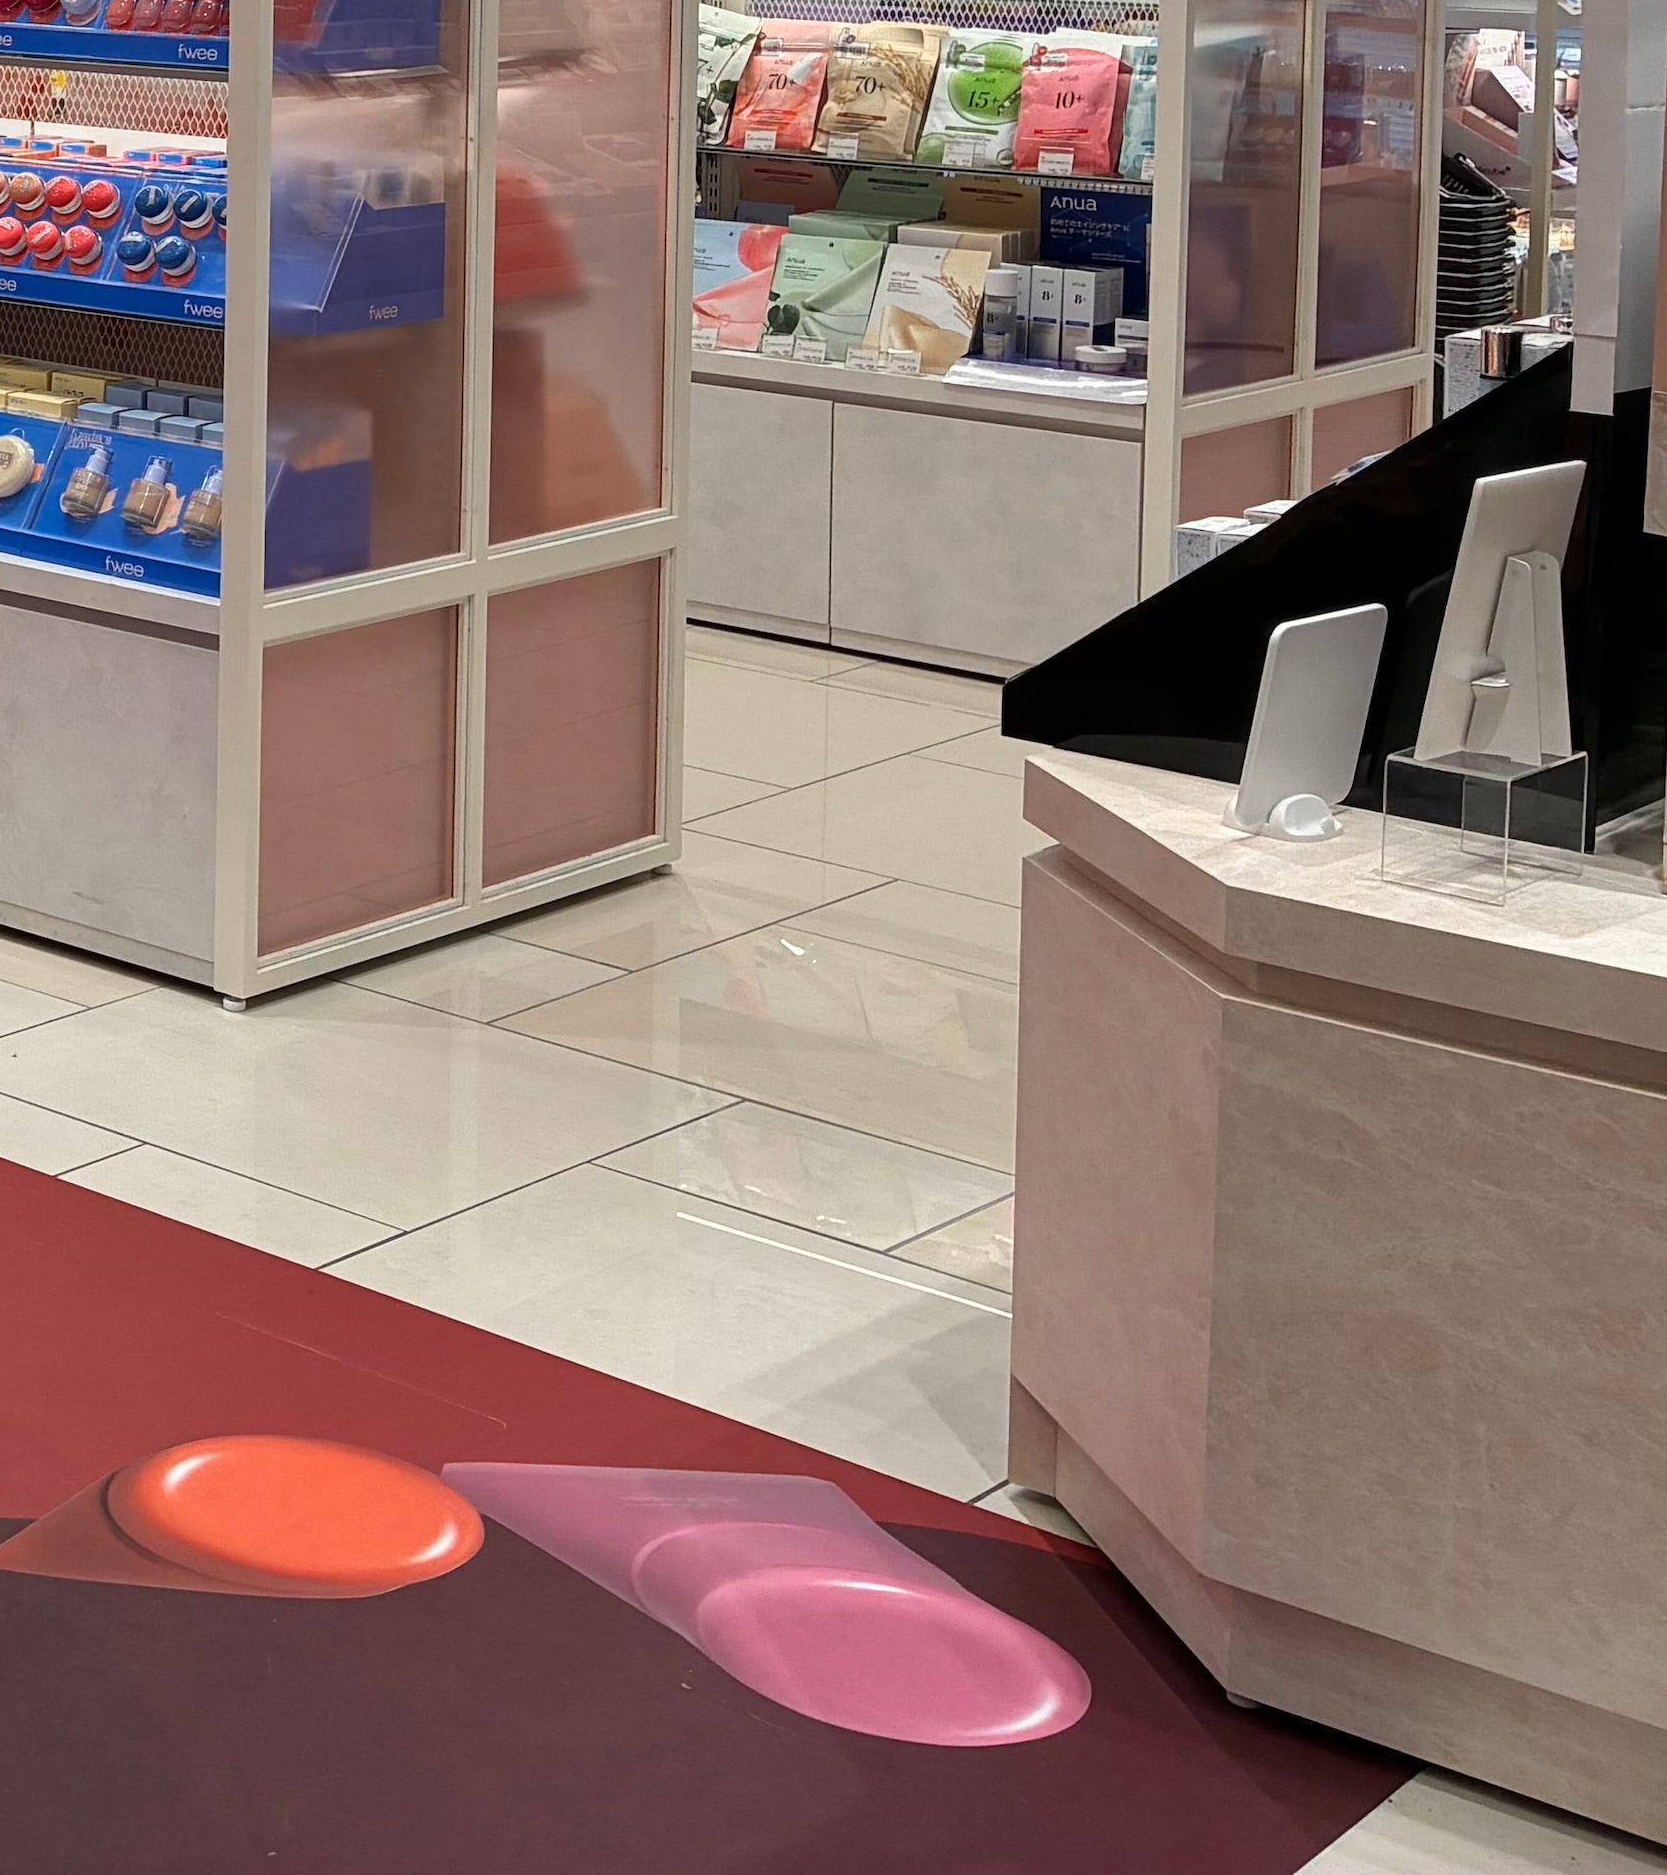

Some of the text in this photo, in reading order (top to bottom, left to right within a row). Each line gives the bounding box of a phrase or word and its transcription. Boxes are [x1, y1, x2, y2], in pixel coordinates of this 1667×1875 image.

[177, 43, 219, 62] fwee
[768, 74, 797, 90] 70+
[855, 76, 887, 94] 70+
[1050, 196, 1097, 211] Anua
[184, 300, 224, 319] fwee
[105, 556, 144, 578] fwee
